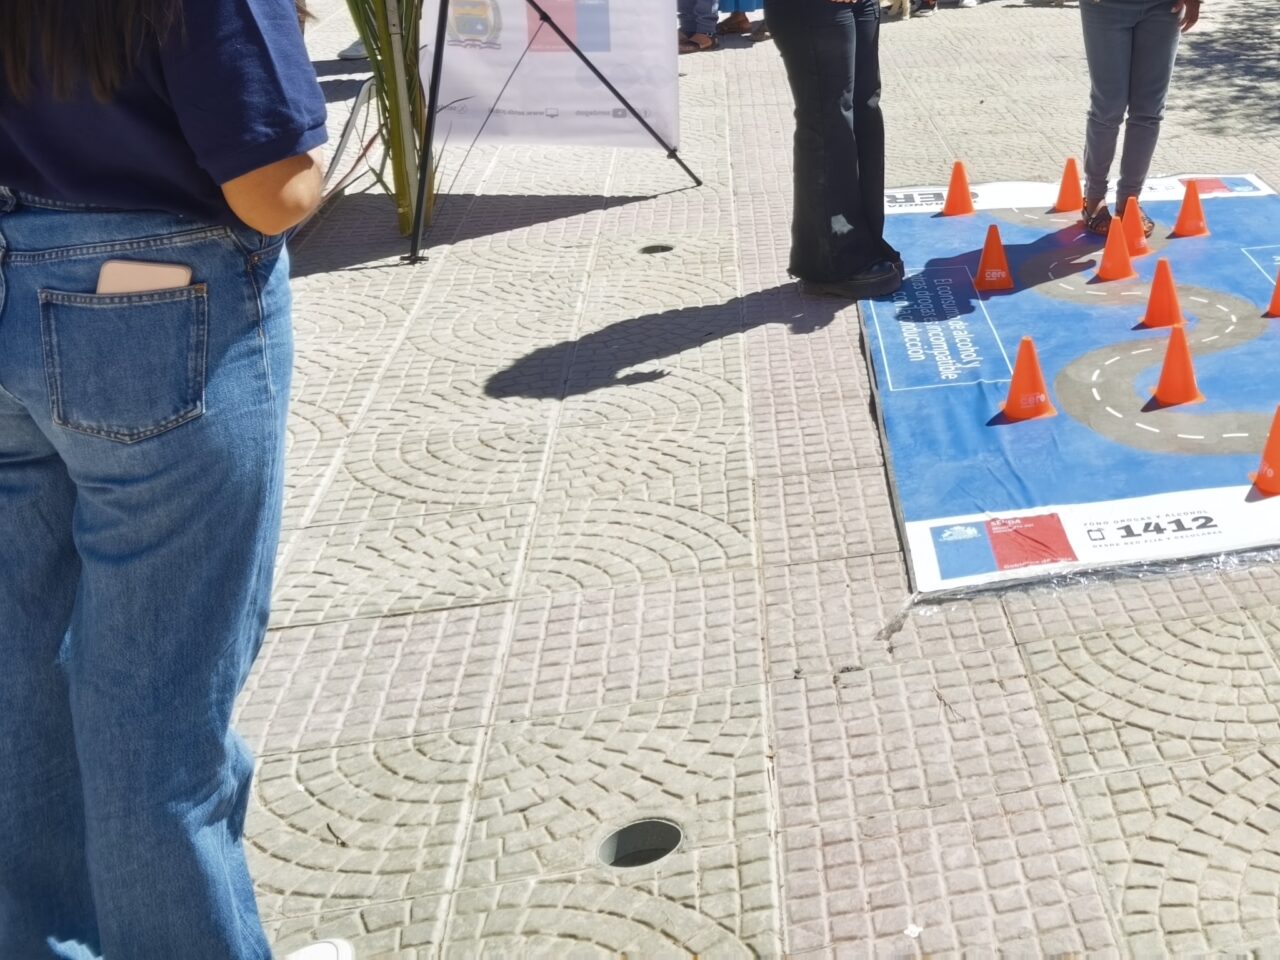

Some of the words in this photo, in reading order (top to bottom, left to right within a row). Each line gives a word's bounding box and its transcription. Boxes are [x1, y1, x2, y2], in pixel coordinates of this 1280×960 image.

[912, 290, 935, 318] drogas
[924, 324, 962, 380] incompatible
[952, 330, 985, 360] alcohol
[1116, 515, 1218, 538] 1412
